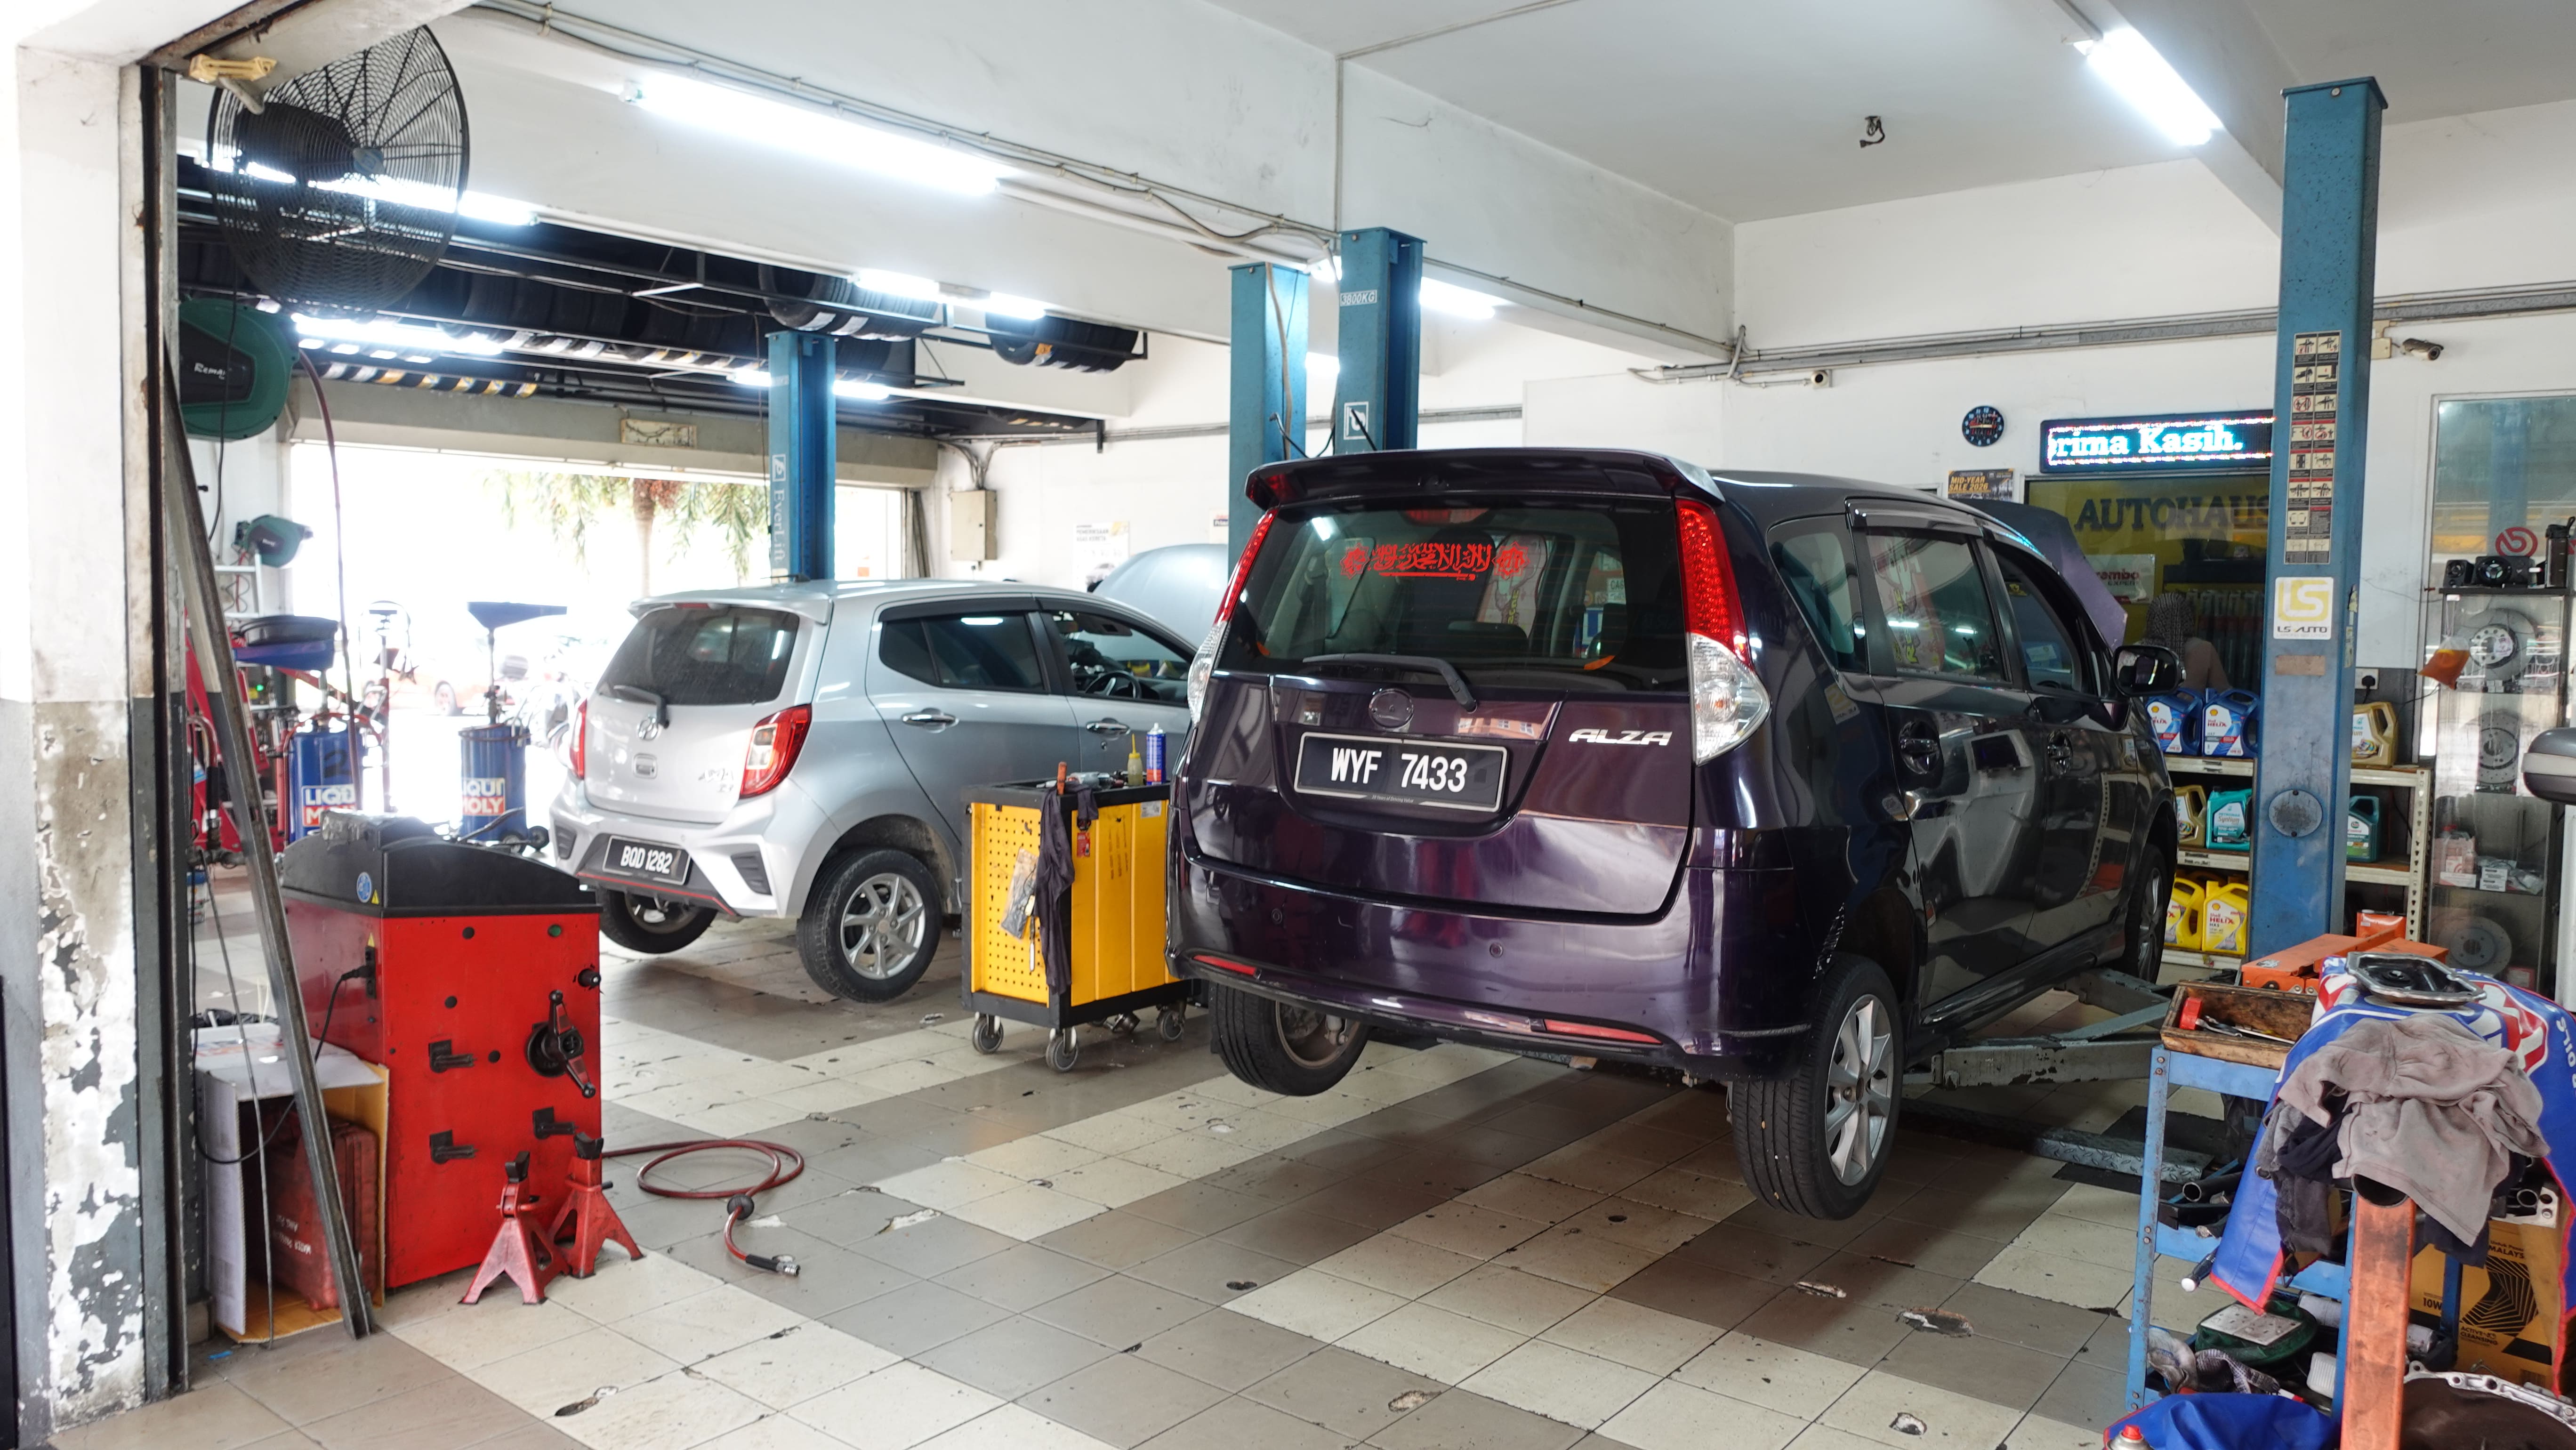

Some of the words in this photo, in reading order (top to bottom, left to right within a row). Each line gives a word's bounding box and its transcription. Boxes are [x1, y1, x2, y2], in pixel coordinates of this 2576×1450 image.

[1341, 291, 1375, 306] 3800KG
[2139, 424, 2244, 454] Kasih.
[1949, 483, 1967, 491] SALE
[1951, 475, 1986, 484] MID-YEAR
[773, 489, 785, 562] EverLift
[2095, 569, 2140, 580] rembo
[1569, 728, 1673, 746] ALZA
[1331, 747, 1382, 784] WYF
[1401, 753, 1468, 793] 7433
[305, 786, 354, 806] LIQU
[463, 778, 501, 797] IQUI
[645, 849, 673, 875] 1282
[2209, 916, 2235, 925] HELIX
